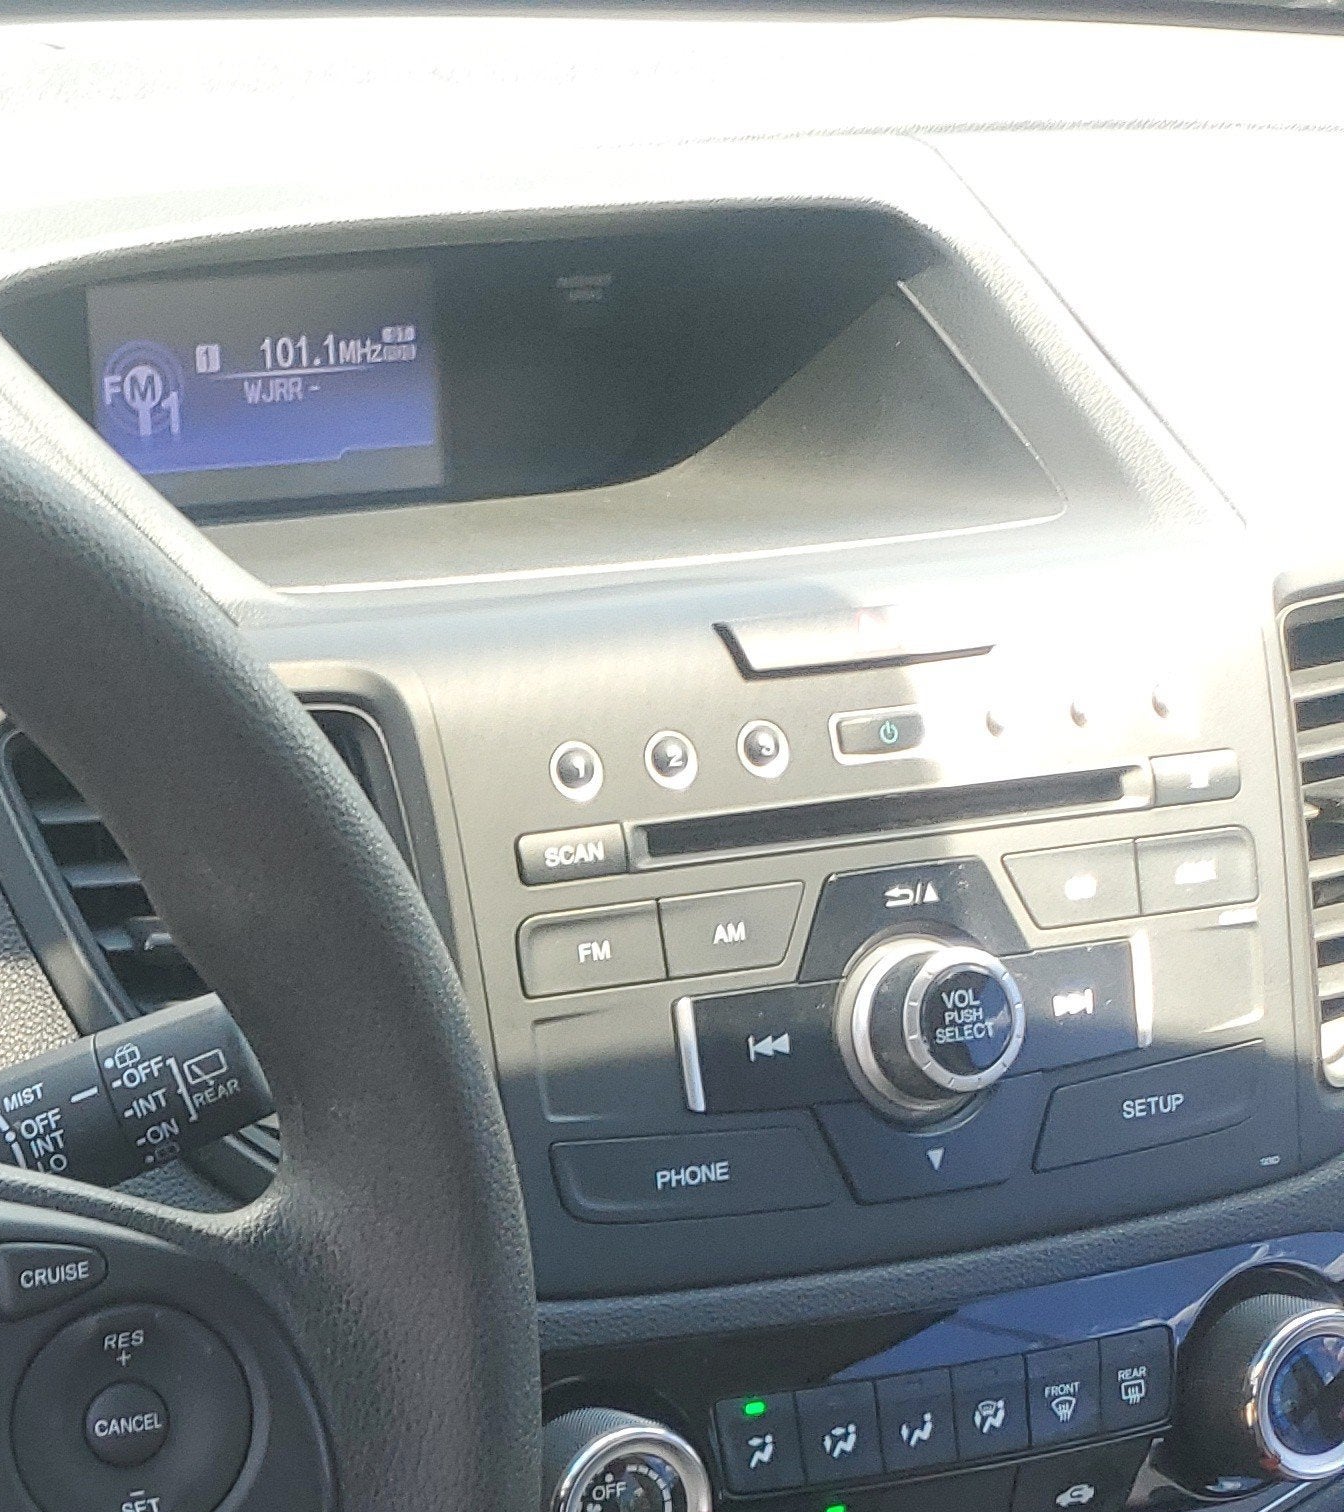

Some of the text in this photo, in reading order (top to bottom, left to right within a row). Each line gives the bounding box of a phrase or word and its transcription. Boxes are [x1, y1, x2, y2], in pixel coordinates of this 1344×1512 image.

[244, 377, 303, 403] WJRR
[544, 840, 606, 868] SCAN
[712, 921, 746, 945] AM
[577, 939, 611, 964] FM
[940, 987, 981, 1009] VOL
[944, 1007, 983, 1026] PUSH
[935, 1021, 994, 1045] SELECT
[123, 1056, 164, 1090] OFF
[2, 1081, 44, 1114] MIST
[133, 1088, 168, 1118] INT
[193, 1078, 242, 1109] REAR
[1122, 1093, 1185, 1119] SETUP
[20, 1108, 63, 1138] OFF
[145, 1117, 180, 1146] ON
[30, 1130, 65, 1158] INT
[655, 1159, 730, 1190] PHONE
[20, 1261, 90, 1288] CRUISE
[102, 1329, 145, 1352] RES
[1116, 1366, 1148, 1384] REAR
[1044, 1380, 1081, 1400] FRONT
[94, 1413, 162, 1437] CANCEL
[592, 1480, 627, 1502] OFF
